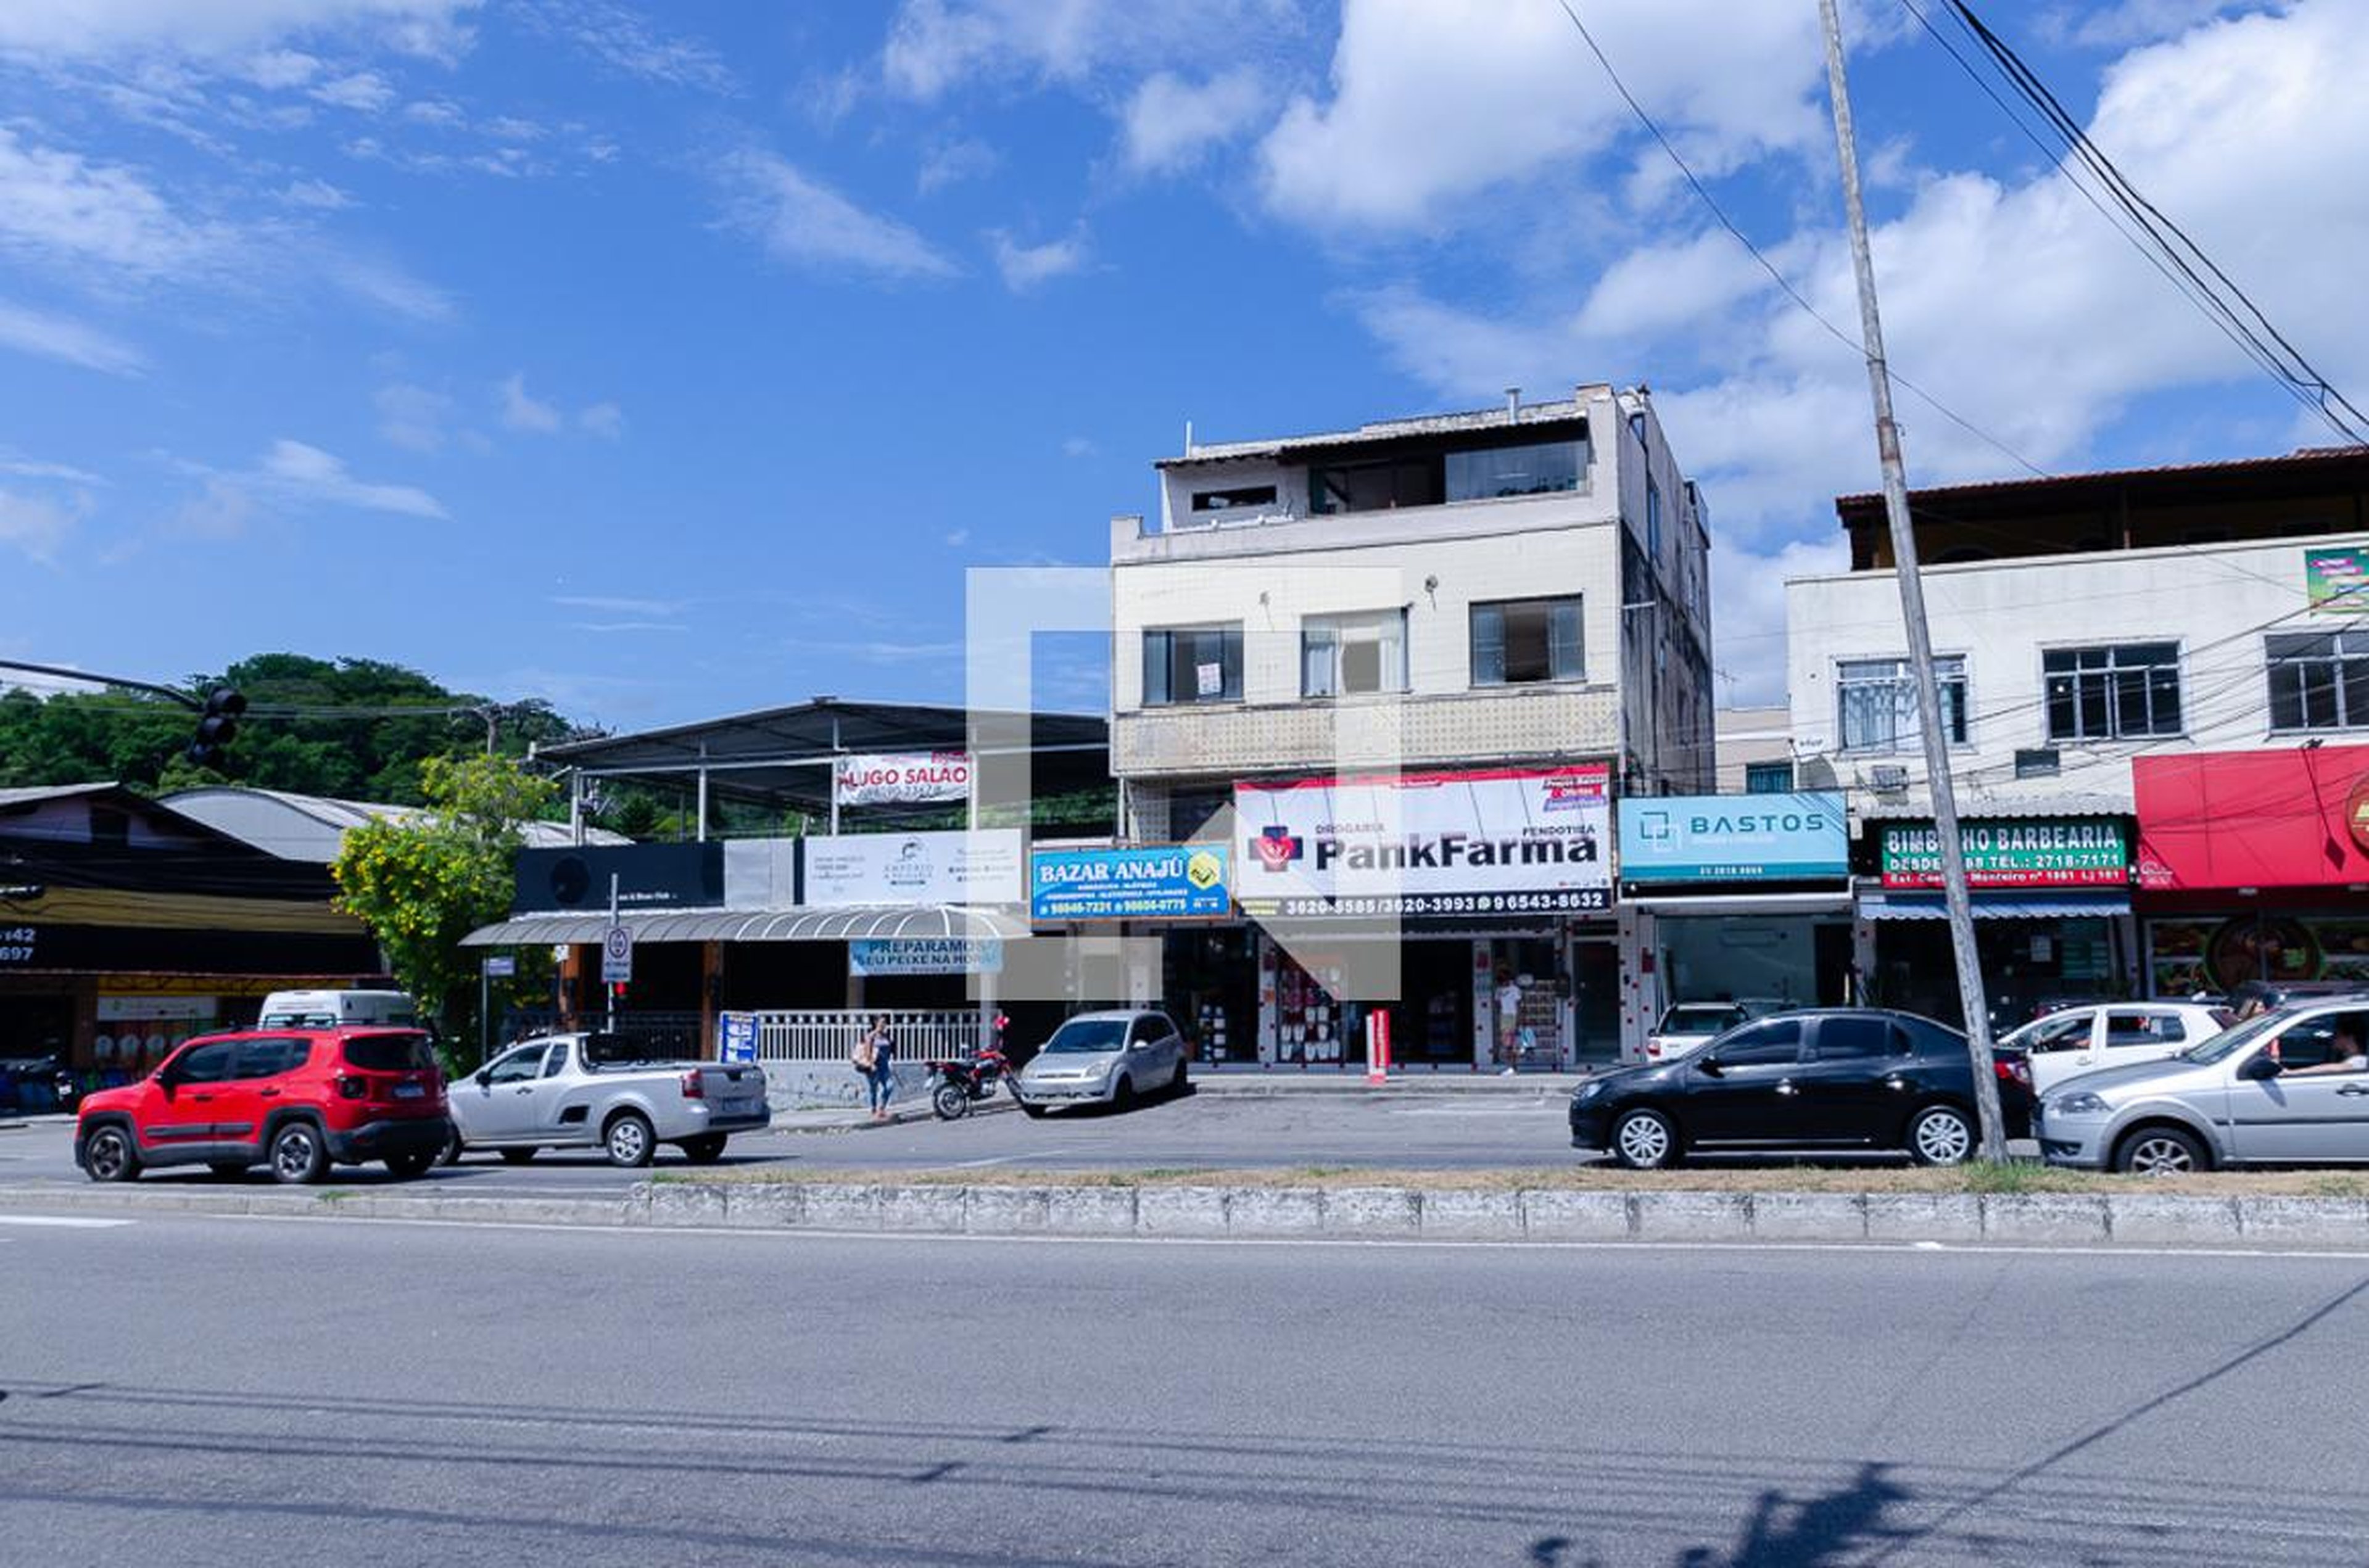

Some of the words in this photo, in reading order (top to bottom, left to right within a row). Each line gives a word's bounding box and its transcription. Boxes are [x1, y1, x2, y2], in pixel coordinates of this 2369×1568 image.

[1691, 814, 1824, 833] BASTOS
[1316, 833, 1598, 870] PankFarma
[1888, 829, 1990, 853] BIMBHO
[1998, 825, 2117, 850] BARBEARIA
[1040, 864, 1110, 882] BAZAR
[1115, 856, 1183, 880] ANAJÚ
[887, 954, 928, 965] PEIXE
[932, 954, 950, 964] NA
